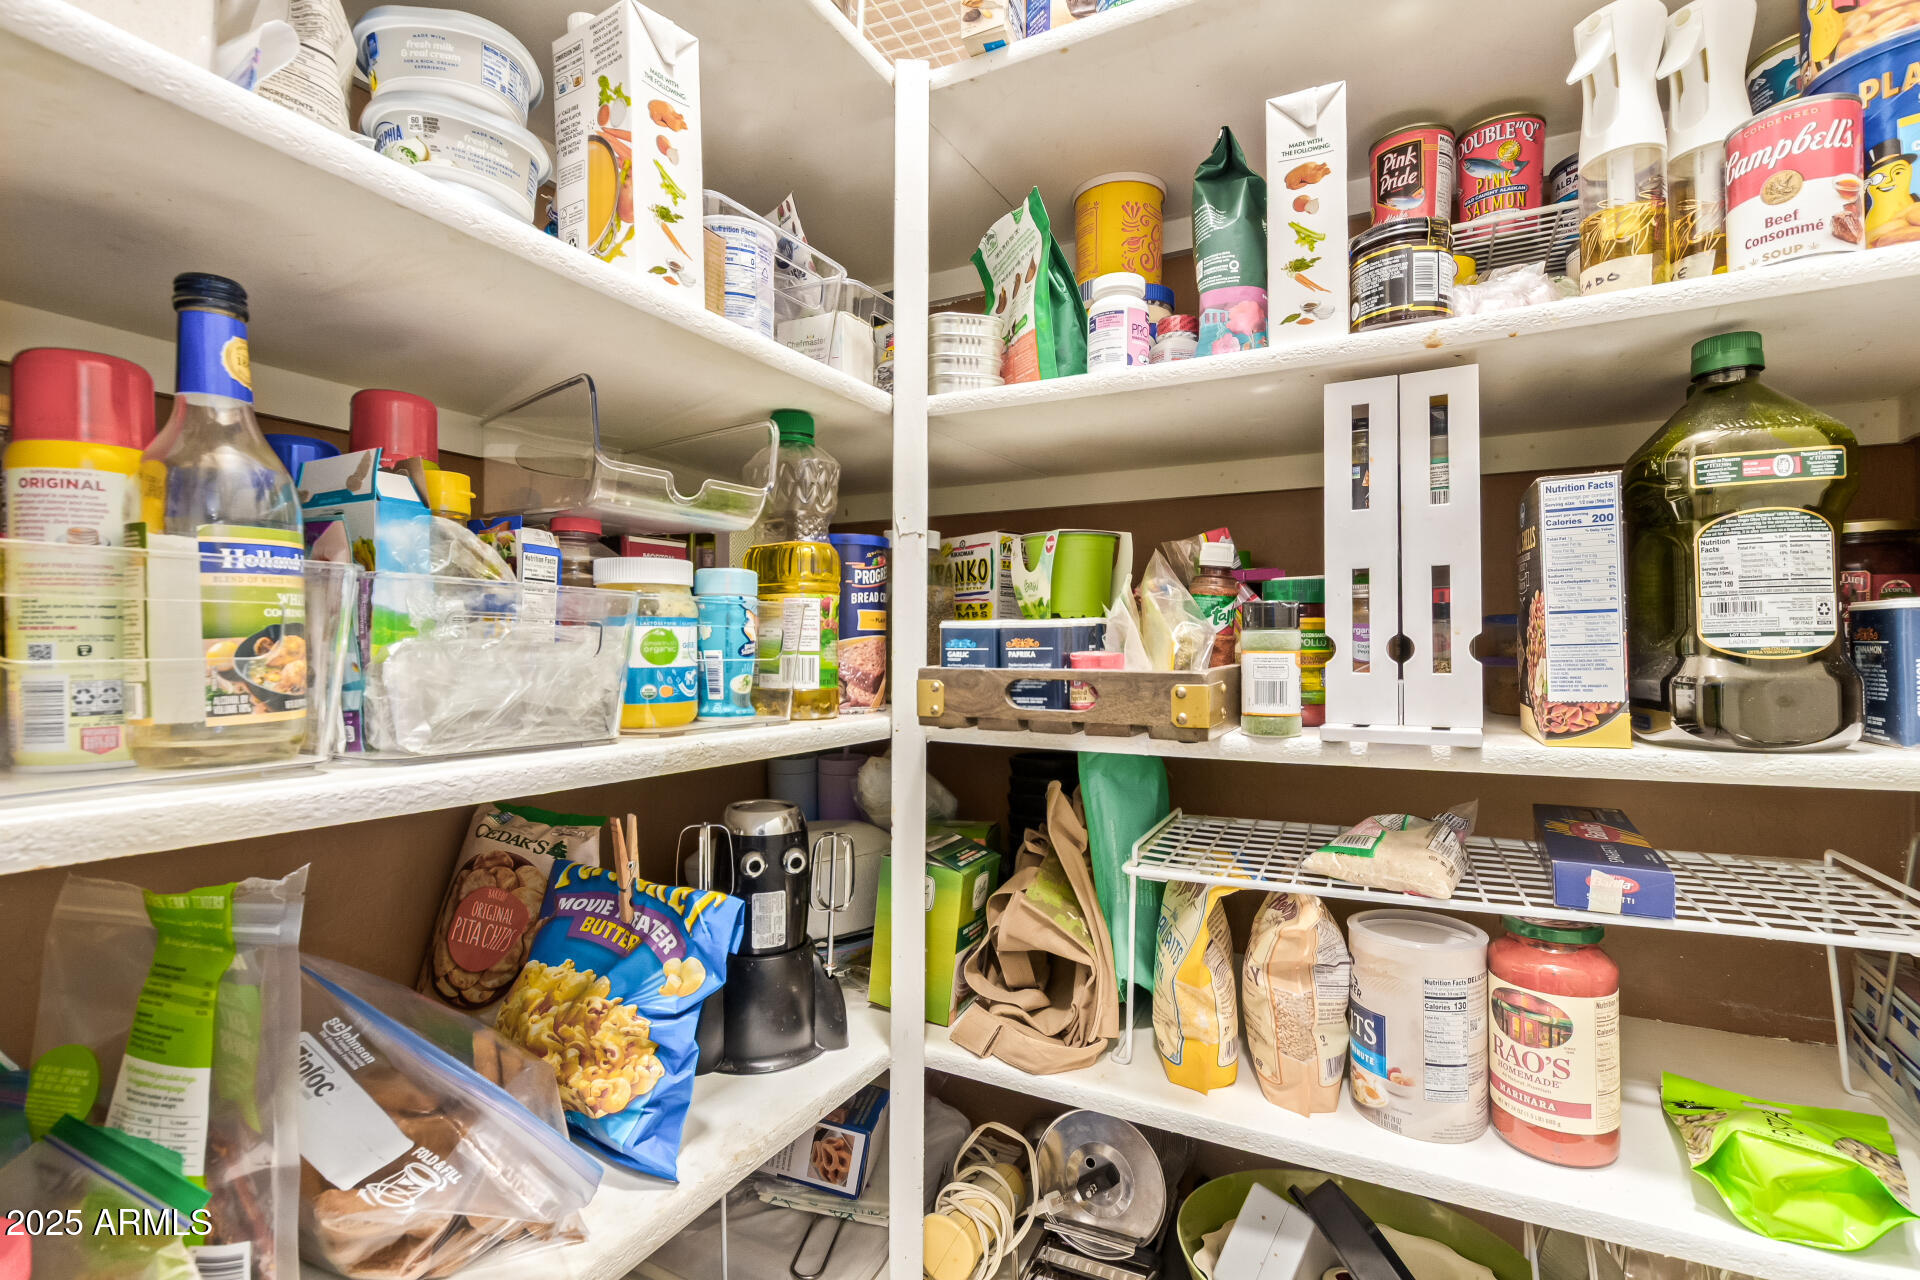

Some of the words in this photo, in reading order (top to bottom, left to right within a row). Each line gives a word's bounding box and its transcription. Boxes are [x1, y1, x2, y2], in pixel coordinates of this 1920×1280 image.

[406, 39, 432, 50] fresh
[432, 41, 455, 52] milk
[410, 49, 429, 58] real
[430, 52, 461, 62] cream
[644, 71, 654, 82] THE
[648, 66, 663, 79] MADE
[663, 75, 680, 89] WITH
[1743, 107, 1819, 138] CONDENSED
[1288, 140, 1306, 151] MADE
[1306, 137, 1323, 147] WITH
[1457, 124, 1516, 160] DOUBLE
[1281, 149, 1293, 158] THE
[1382, 144, 1418, 175] Pink
[1725, 118, 1855, 188] Campbell's
[1379, 169, 1418, 198] Pride
[1475, 169, 1514, 194] PINK
[1474, 189, 1499, 202] CAUGHT
[1499, 185, 1526, 195] ALASKAN
[1465, 191, 1527, 222] SALMON
[1764, 209, 1800, 229] Beef
[1761, 243, 1805, 262] SOUP
[18, 477, 106, 492] ORIGINAL
[1545, 483, 1586, 494] Nutrition
[1587, 480, 1615, 491] Facts
[1545, 517, 1583, 527] Calories
[1591, 512, 1615, 524] 200
[1700, 538, 1731, 547] Nutrition
[1701, 579, 1723, 587] Calories
[1723, 580, 1734, 588] 120
[851, 591, 879, 604] BREAD
[946, 650, 970, 658] GARLIC
[1007, 650, 1037, 658] PAPRIKA
[475, 823, 550, 856] CEDAR'S
[471, 900, 516, 924] ORIGINAL
[557, 896, 615, 915] MOVIE
[451, 915, 482, 948] PITA
[481, 921, 519, 953] CHIPS
[579, 914, 642, 953] BUTTER
[1452, 978, 1467, 986] Facts
[1425, 1001, 1451, 1010] Calories
[1454, 1001, 1467, 1010] 130
[1493, 1032, 1572, 1080] RAO'S
[1497, 1059, 1560, 1089] HOMEMADE
[1499, 1081, 1559, 1113] MARINARA
